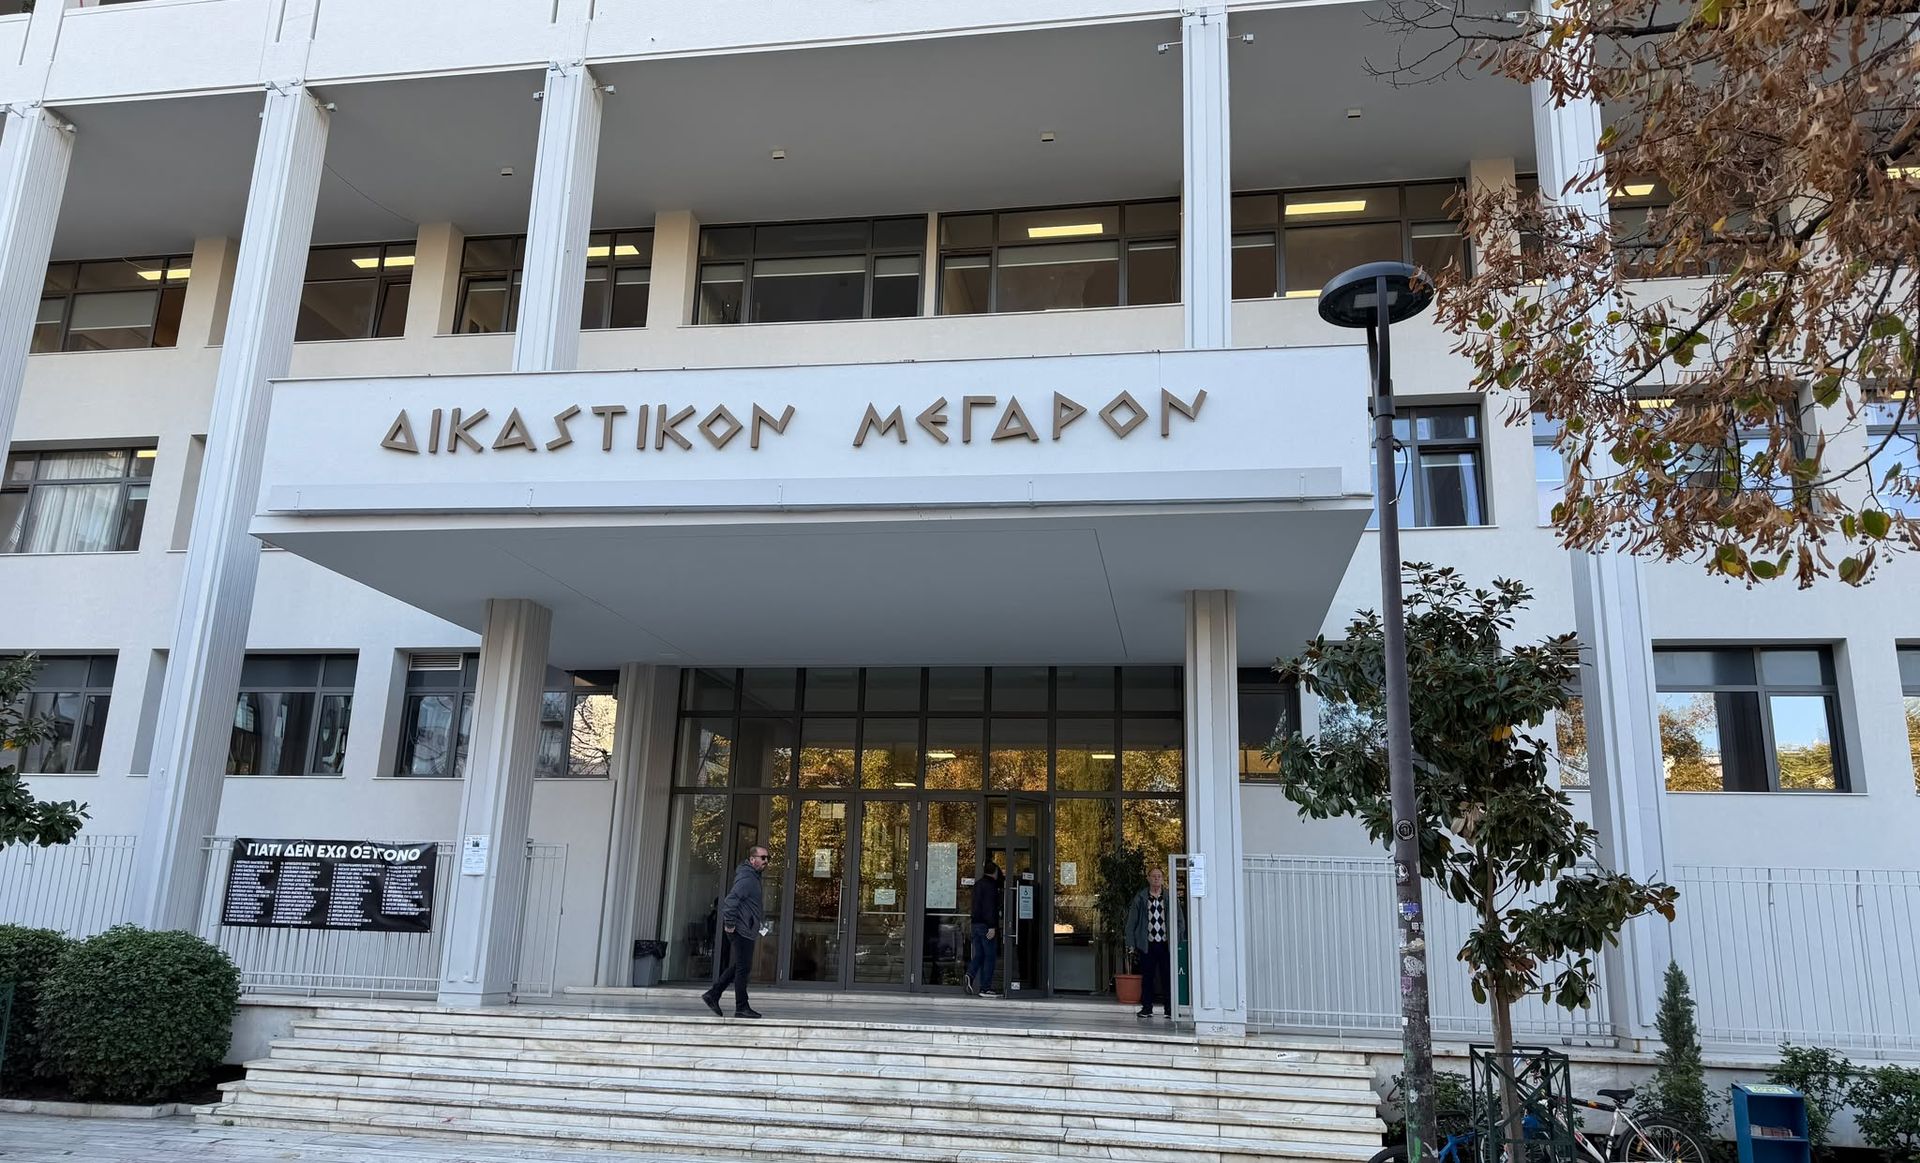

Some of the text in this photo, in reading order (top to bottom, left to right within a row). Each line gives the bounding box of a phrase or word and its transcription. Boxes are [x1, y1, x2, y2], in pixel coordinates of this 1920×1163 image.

[382, 388, 1208, 454] ΔΙΚΑΣΤΙΚΟΝ ΜΕΓΑΡΟΝ
[247, 843, 282, 857] ΓΙΑΤΙ
[284, 844, 314, 858] ΔΕΝ
[317, 846, 347, 859] ΕΧΩ
